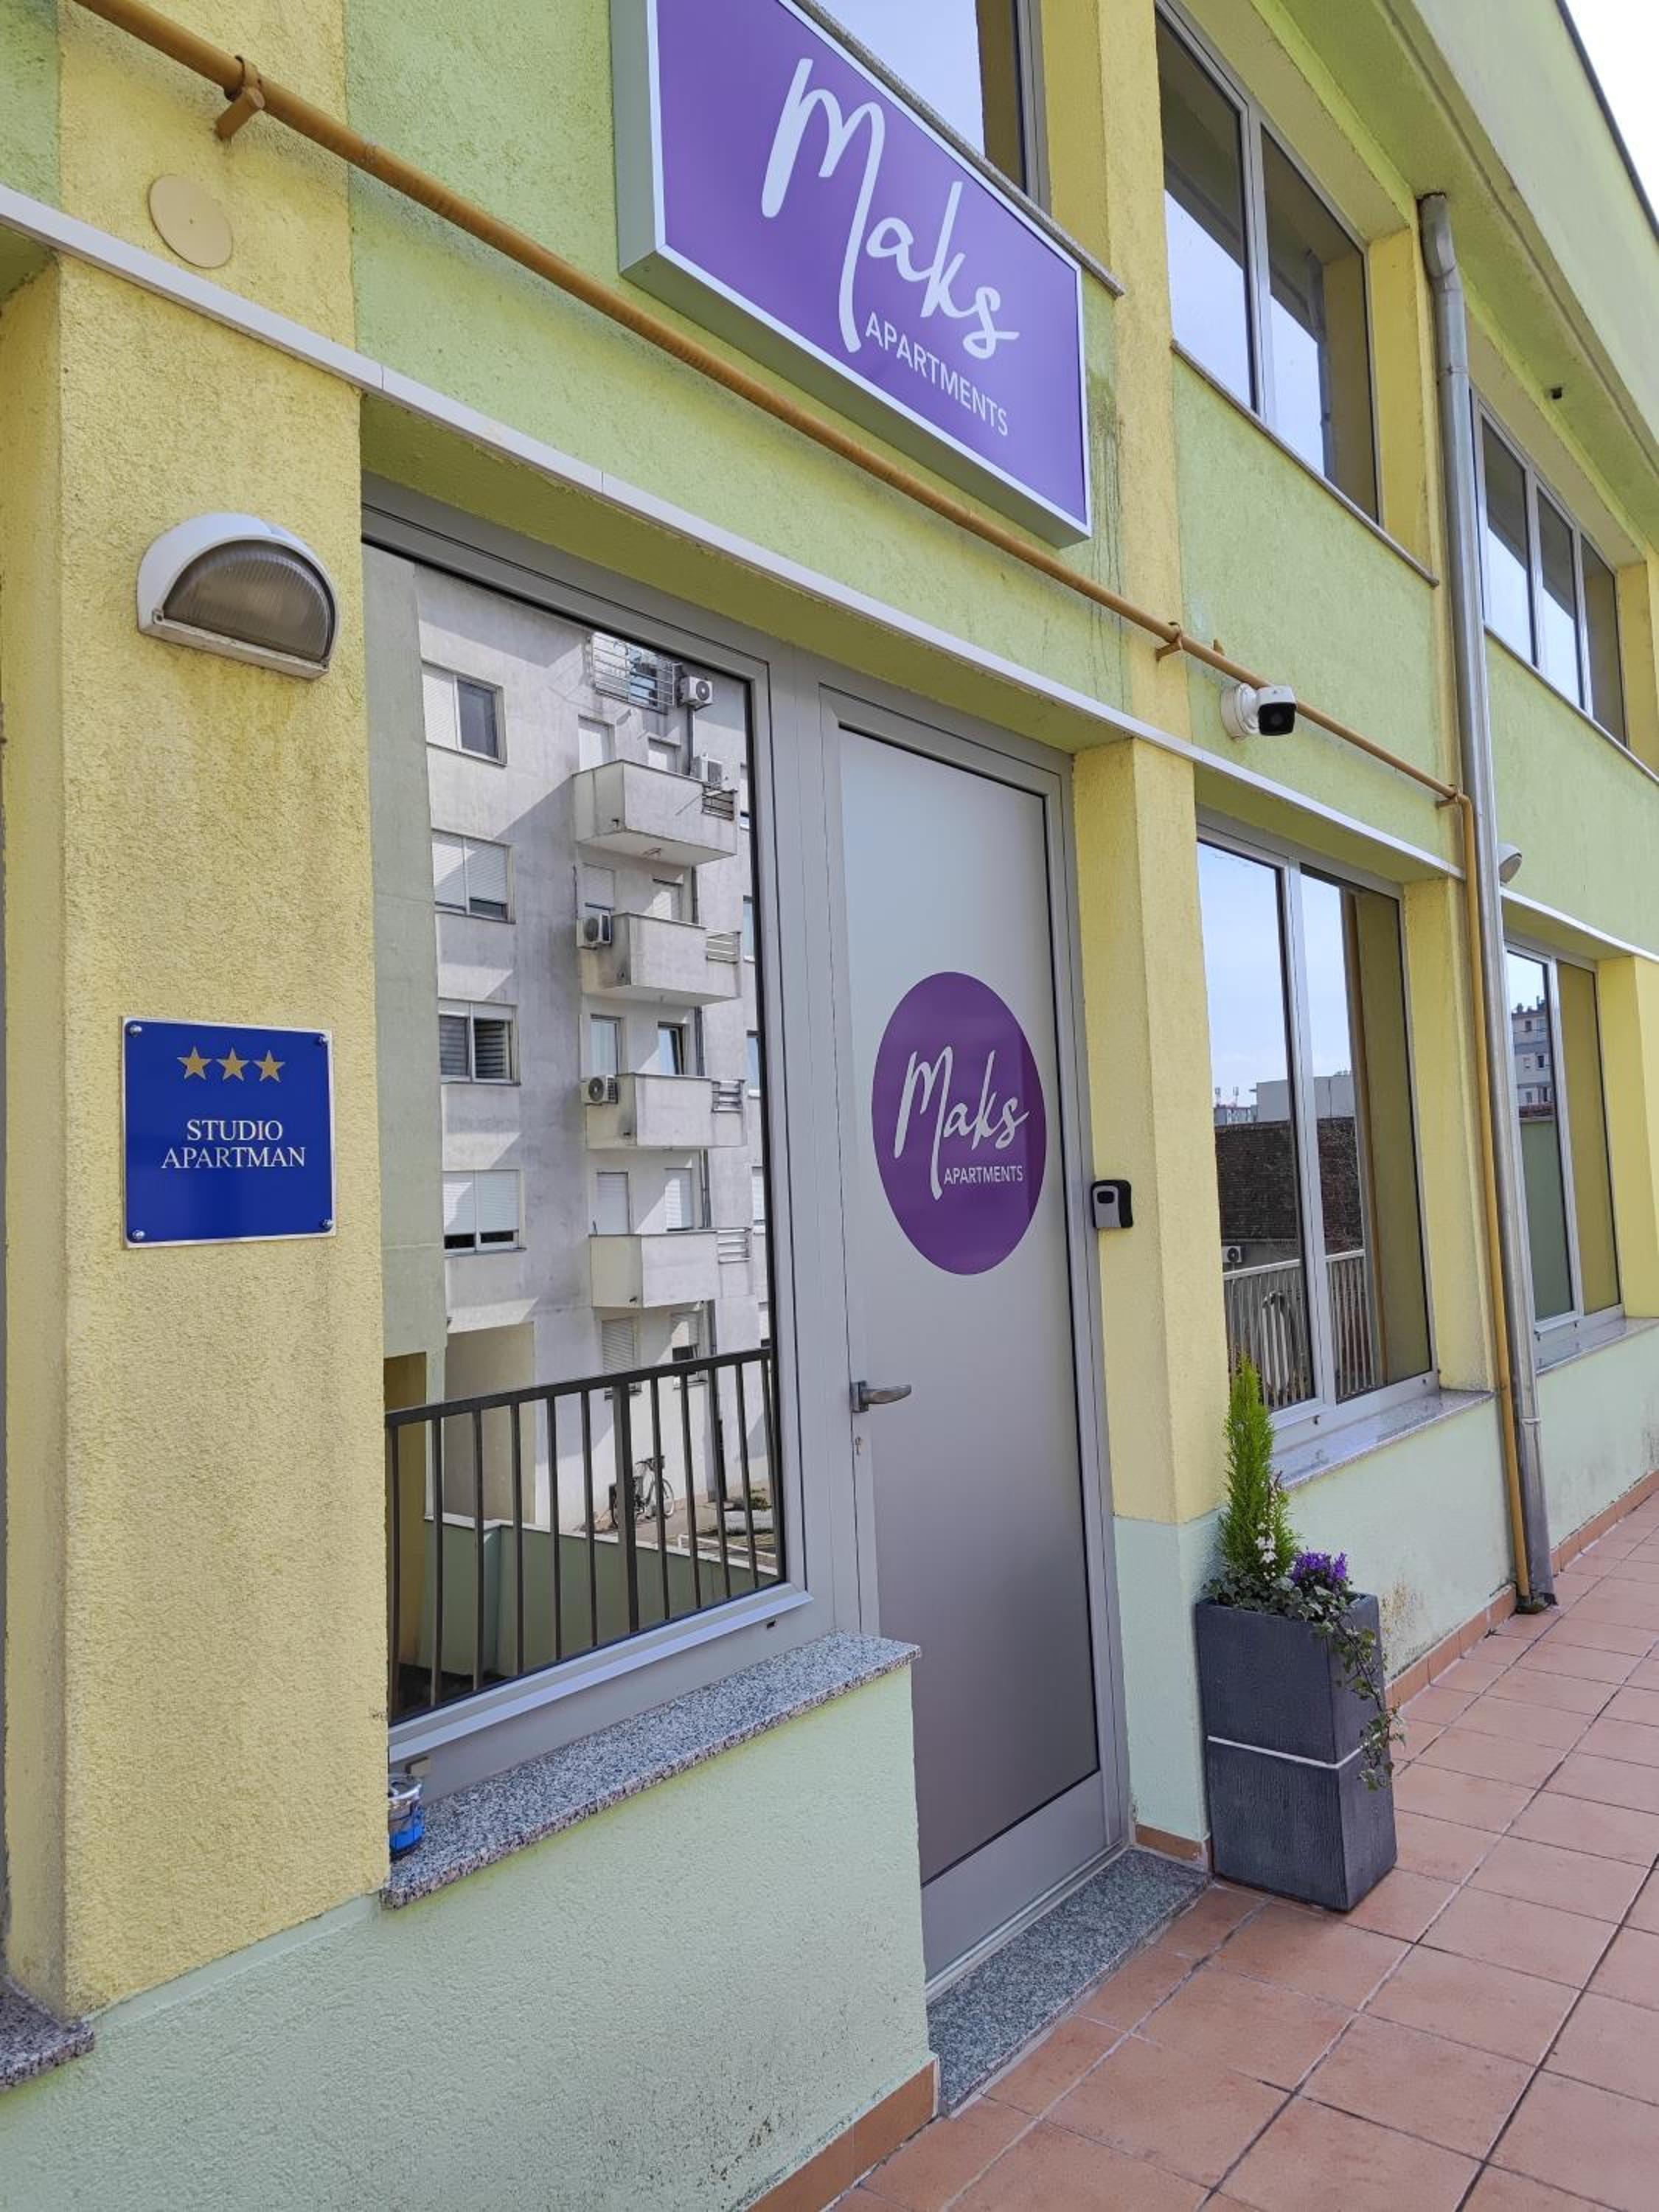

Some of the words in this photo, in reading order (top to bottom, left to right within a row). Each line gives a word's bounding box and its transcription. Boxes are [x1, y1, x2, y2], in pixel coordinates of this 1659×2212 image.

[761, 58, 1020, 358] Maks
[864, 312, 1009, 437] APARTMENTS
[161, 1147, 306, 1169] APARTMAN
[187, 1119, 283, 1141] STUDIO
[894, 1046, 1030, 1201] Maks
[943, 1165, 1023, 1184] APARTMENTS
